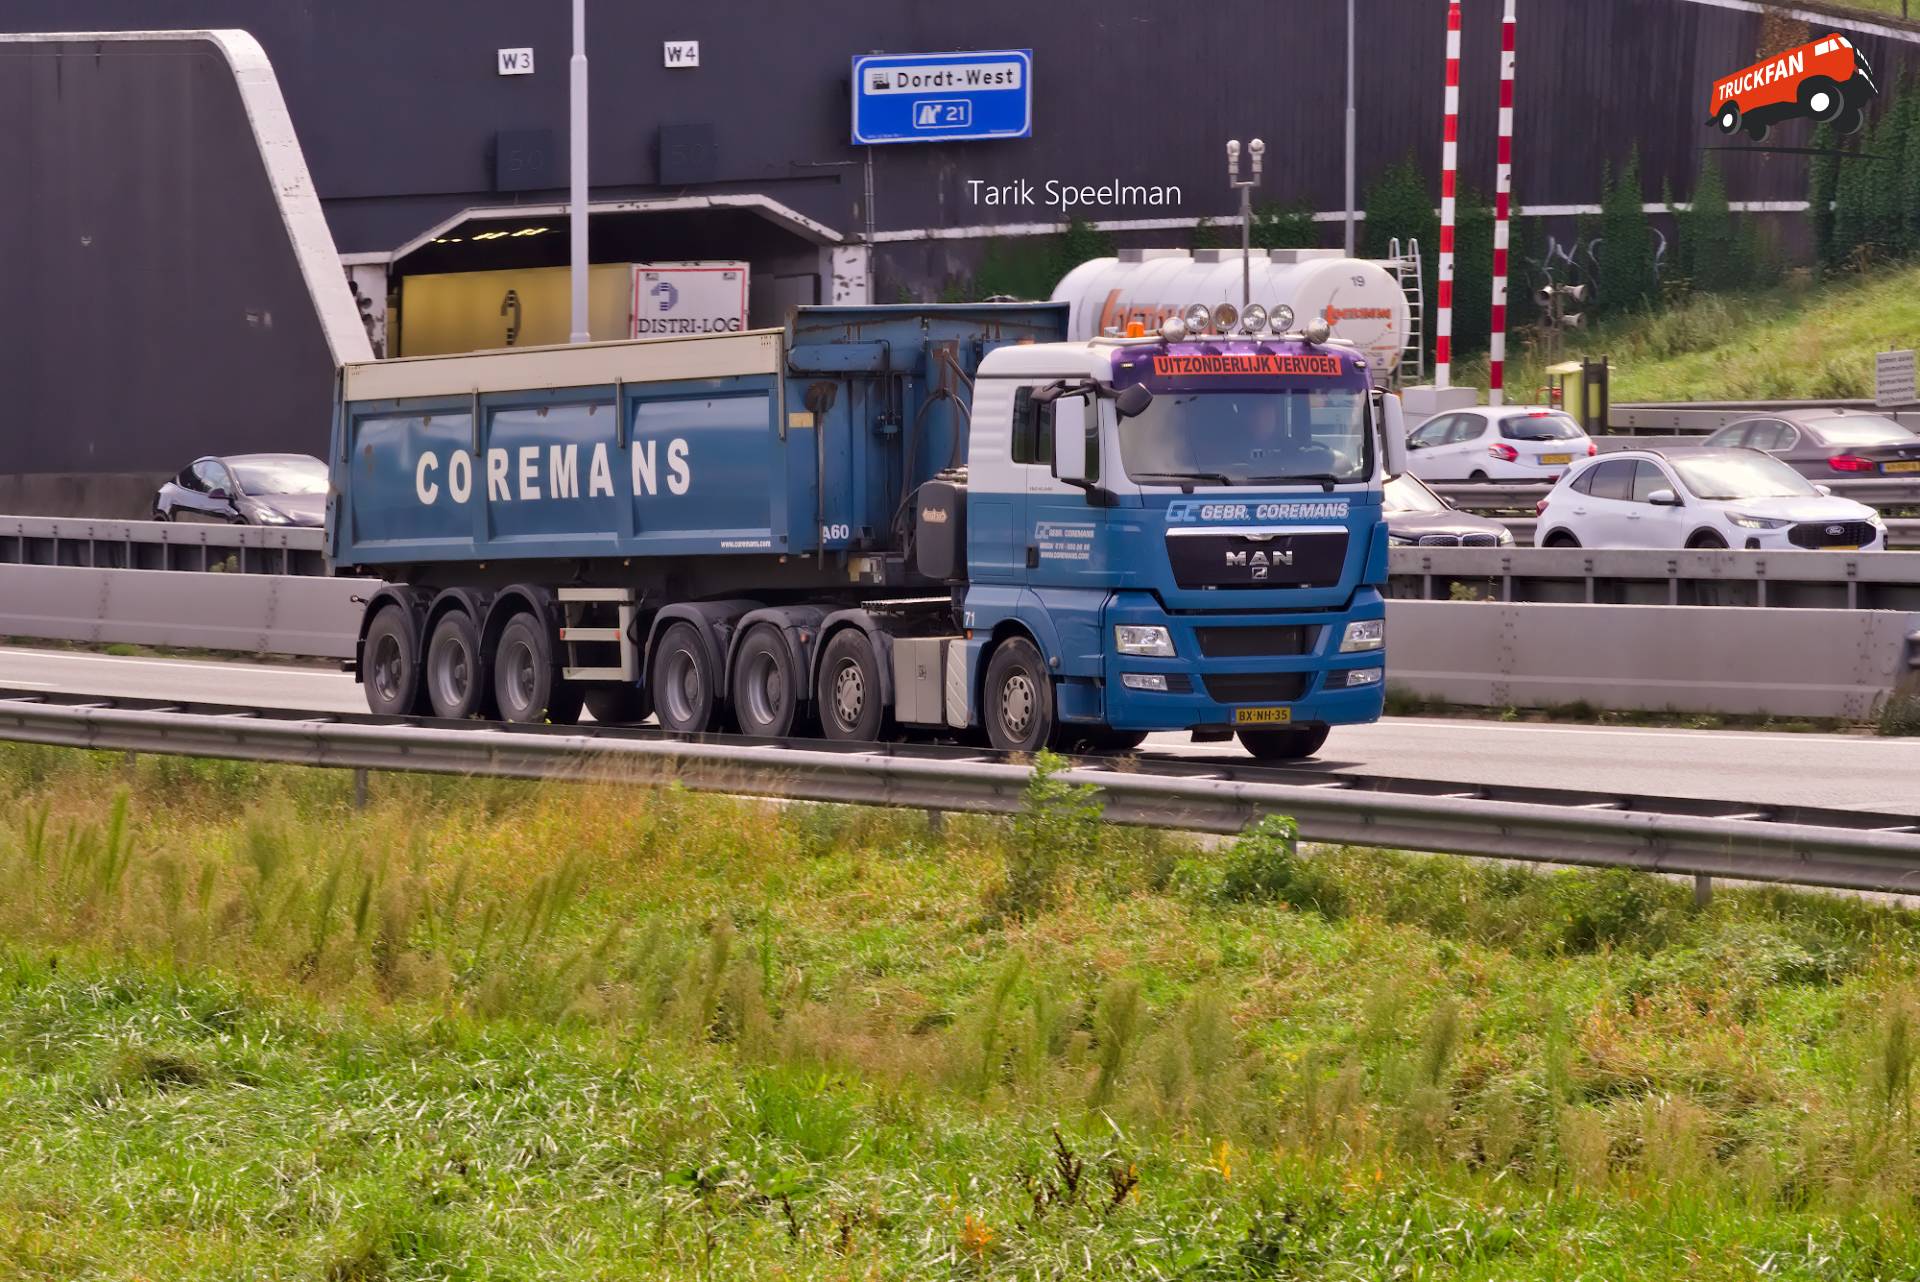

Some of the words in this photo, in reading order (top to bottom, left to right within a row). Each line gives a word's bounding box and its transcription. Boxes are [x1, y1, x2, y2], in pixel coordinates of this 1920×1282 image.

[502, 53, 531, 70] W3
[667, 46, 697, 63] W4
[897, 69, 1013, 88] Dordt-West
[946, 106, 965, 121] 21
[1352, 275, 1365, 287] 19
[638, 318, 740, 333] DISTRI-LOG
[1158, 357, 1270, 374] UITZONDERLIJK
[1274, 357, 1337, 374] VERVOER
[416, 438, 691, 505] COREMANS
[1201, 504, 1250, 521] GEBR.
[1256, 503, 1350, 520] COREMANS
[1226, 551, 1293, 566] MAN
[965, 611, 975, 627] 71
[1238, 710, 1289, 721] BX-NH-35
